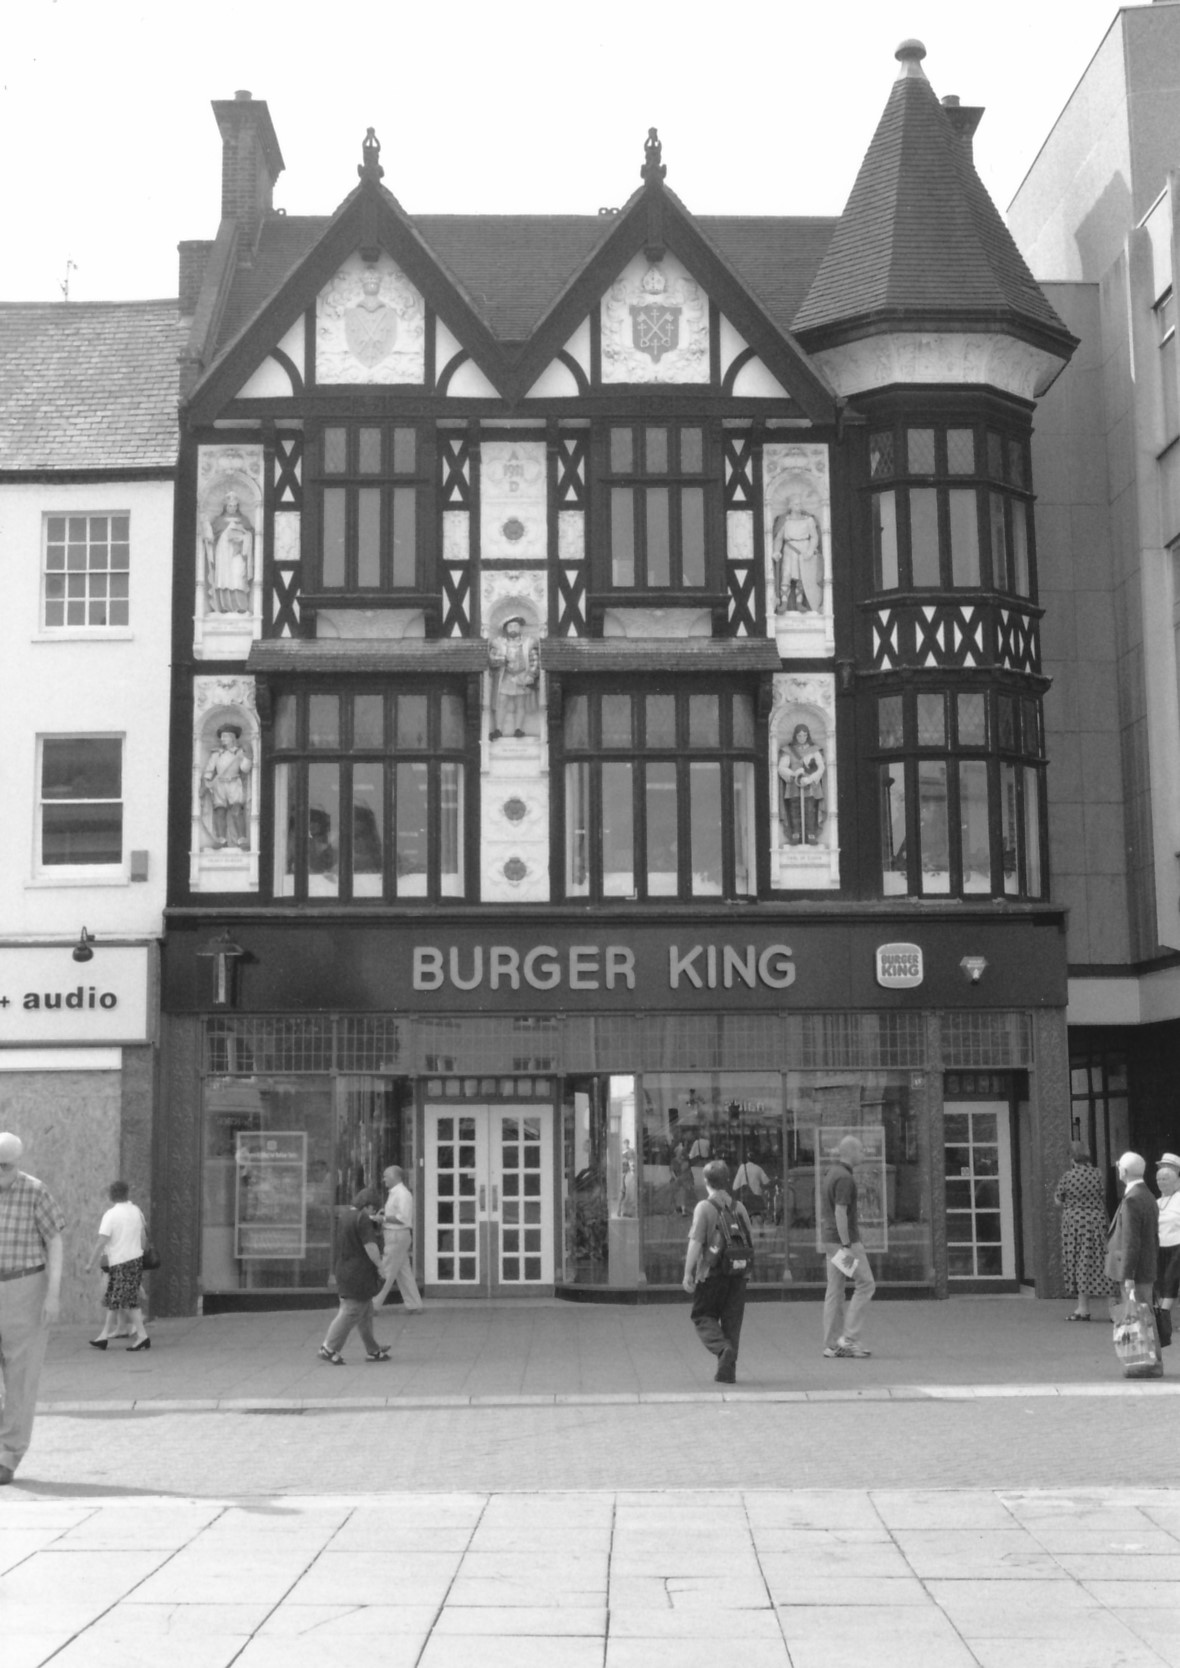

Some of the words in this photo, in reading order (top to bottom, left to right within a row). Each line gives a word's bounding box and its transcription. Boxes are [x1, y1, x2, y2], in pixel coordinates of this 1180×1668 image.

[508, 480, 521, 493] D
[881, 954, 919, 965] BURGER
[412, 945, 637, 991] BURGER
[669, 944, 797, 990] KING
[881, 964, 919, 977] KING
[22, 986, 118, 1010] audio
